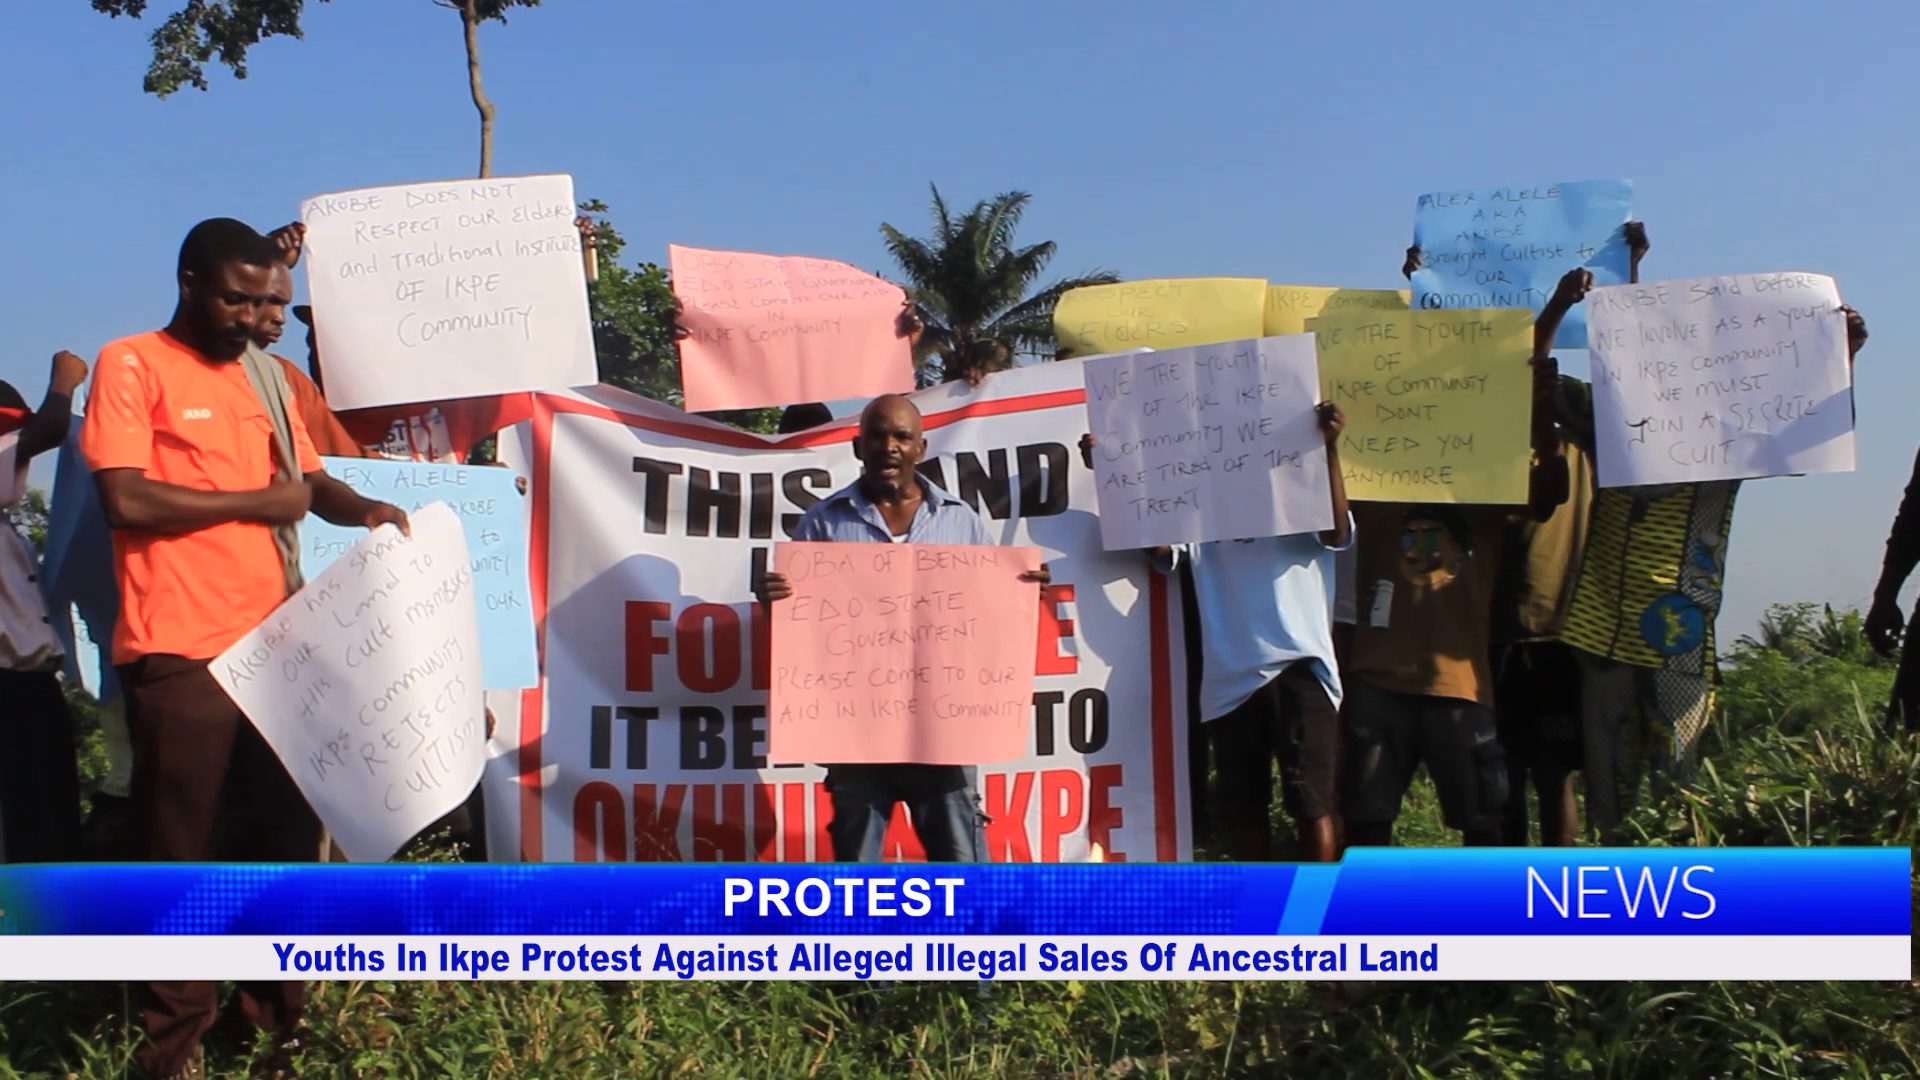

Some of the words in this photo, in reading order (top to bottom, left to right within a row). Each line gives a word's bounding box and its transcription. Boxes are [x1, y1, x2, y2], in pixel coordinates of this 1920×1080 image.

[305, 195, 383, 220] AKOBE
[405, 187, 459, 210] DOES
[471, 183, 516, 199] NOT
[354, 216, 441, 245] RESPECT
[458, 210, 501, 228] OUR
[340, 252, 379, 279] and
[680, 252, 744, 273] OBA
[395, 280, 425, 303] OF
[445, 273, 501, 301] IKPE
[680, 276, 734, 292] EDO
[1590, 289, 1670, 318] AKOBE
[1690, 277, 1740, 304] Said
[1270, 288, 1313, 312] IKPE
[767, 310, 785, 323] IN
[1714, 317, 1743, 335] AS
[1753, 314, 1767, 328] A
[698, 327, 734, 344] IKPE
[1356, 322, 1400, 345] THE
[1416, 320, 1493, 350] YOUTH
[1373, 351, 1402, 372] OF
[1599, 365, 1622, 388] IN
[1638, 359, 1679, 386] IKPE
[1089, 369, 1132, 401] WE
[1146, 362, 1181, 389] THE
[1328, 379, 1376, 401] IKPE
[1653, 387, 1683, 403] WE
[1143, 398, 1166, 416] OF
[1235, 383, 1280, 405] IKPE
[1375, 404, 1440, 424] DONT
[1236, 417, 1273, 443] WE
[1624, 415, 1685, 452] JOIN
[1701, 411, 1716, 430] A
[1343, 434, 1421, 455] NEED
[1436, 433, 1475, 457] YOU
[394, 468, 468, 489] ALELE
[1103, 469, 1147, 491] ARE
[1223, 454, 1250, 473] OF
[1342, 466, 1455, 486] ANYMORE
[633, 456, 832, 540] THIS
[916, 442, 1069, 521] AND
[1128, 488, 1200, 521] TREAT
[480, 529, 501, 546] to
[787, 551, 856, 583] OBA
[873, 550, 896, 572] OF
[915, 550, 1000, 572] BENIN
[303, 577, 341, 613] has
[486, 592, 522, 611] OUR
[791, 596, 864, 622] EDO
[878, 591, 964, 616] STATE
[825, 618, 979, 656] GOVERNMENT
[283, 641, 325, 683] OUR
[777, 667, 857, 694] PLEASE
[868, 667, 931, 688] COME
[944, 666, 965, 682] TO
[978, 667, 1017, 686] OUR
[837, 701, 856, 719] IN
[871, 699, 918, 719] IKPE
[359, 676, 467, 778] REJECTS
[590, 705, 659, 769] IT
[1032, 687, 1109, 756] TO
[309, 728, 352, 783] IKPE
